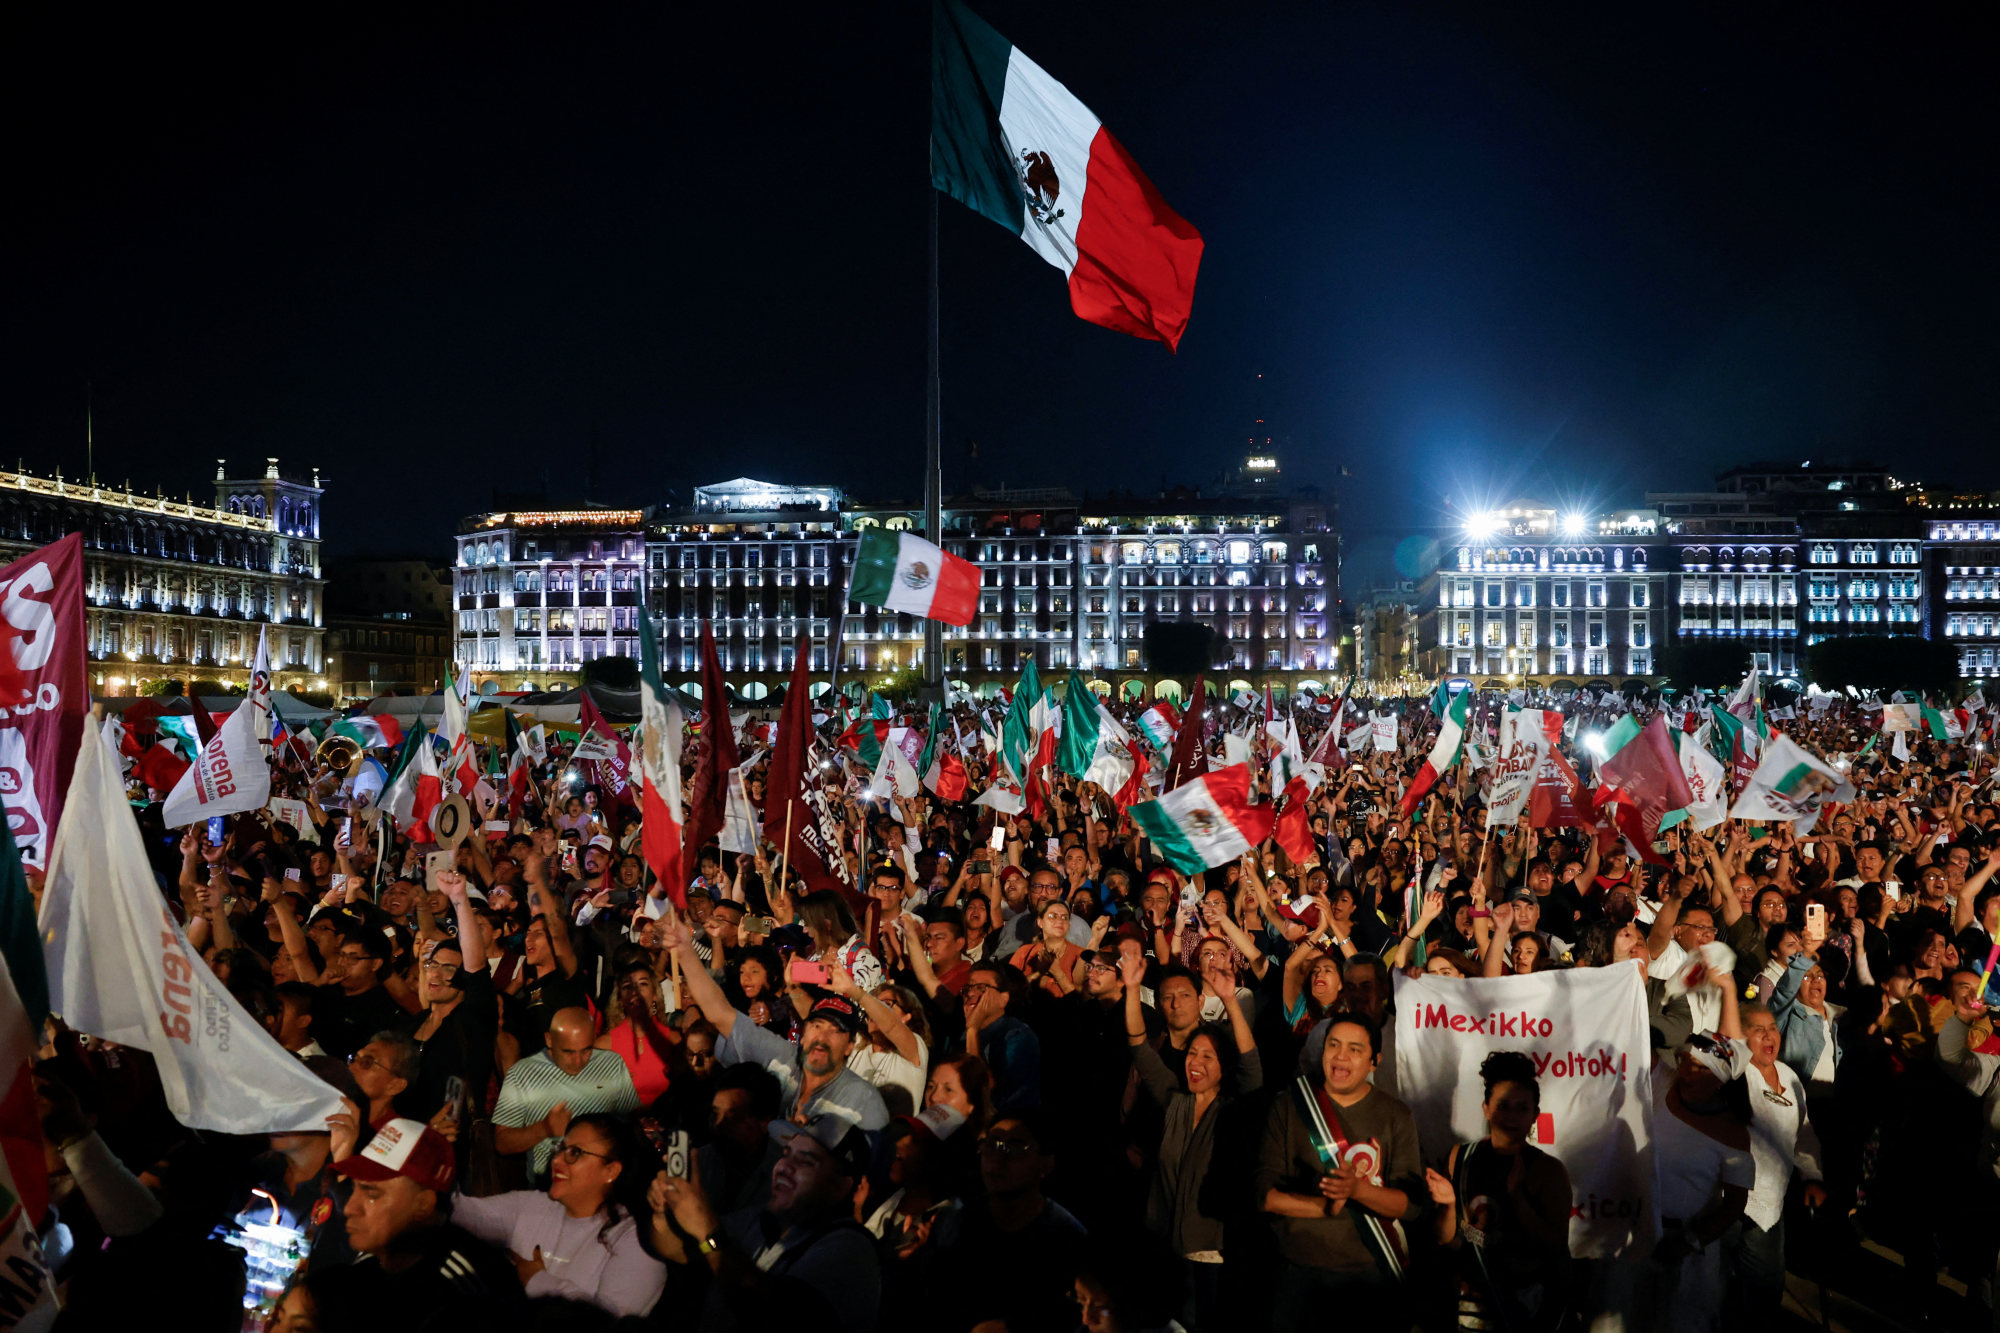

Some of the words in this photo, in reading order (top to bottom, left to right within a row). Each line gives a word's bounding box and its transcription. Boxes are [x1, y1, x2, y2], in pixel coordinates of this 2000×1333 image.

[1415, 1003, 1553, 1038] ¡Mexikko
[1531, 1048, 1628, 1081] Yoltok!
[1569, 1193, 1641, 1224] xico!
